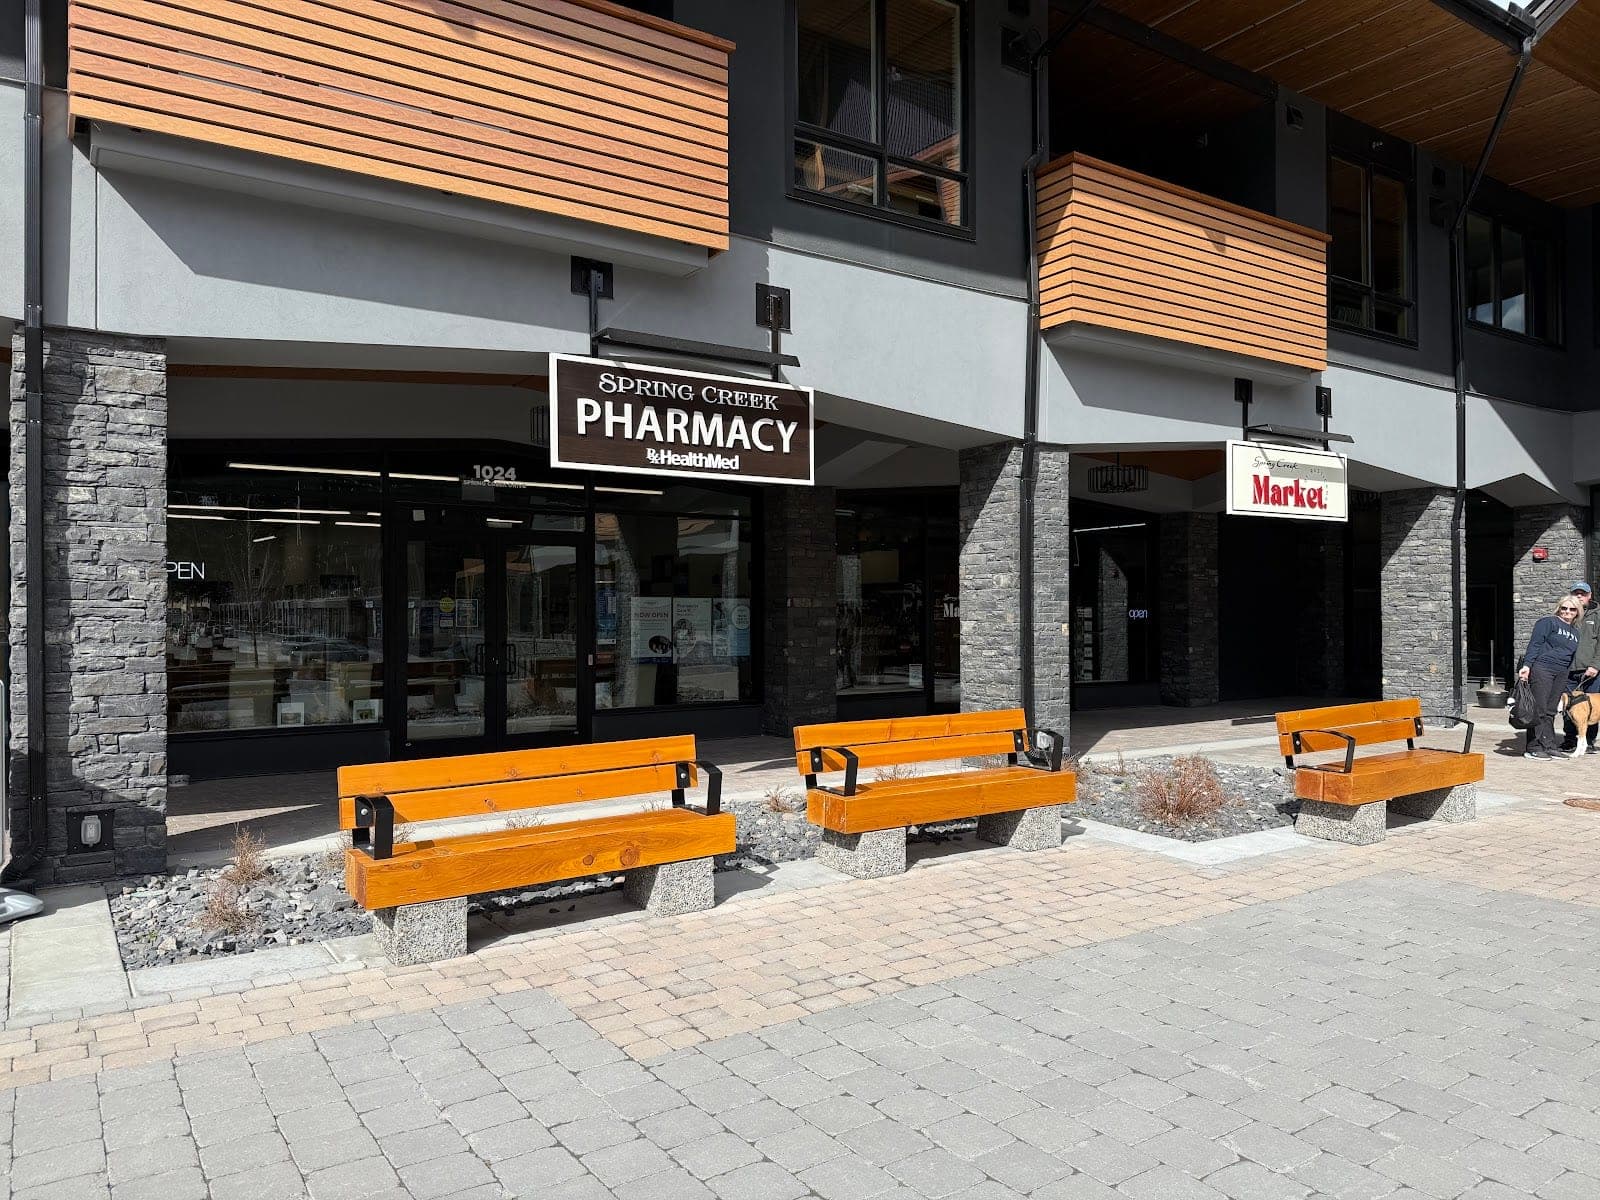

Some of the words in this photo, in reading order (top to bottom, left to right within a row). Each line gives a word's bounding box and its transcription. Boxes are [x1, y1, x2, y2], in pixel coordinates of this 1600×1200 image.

[599, 373, 694, 400] SPRING
[701, 386, 779, 411] CREEK
[577, 398, 798, 453] PHARMACY
[473, 464, 516, 480] 1024
[166, 561, 205, 580] PEN
[1128, 609, 1148, 620] open
